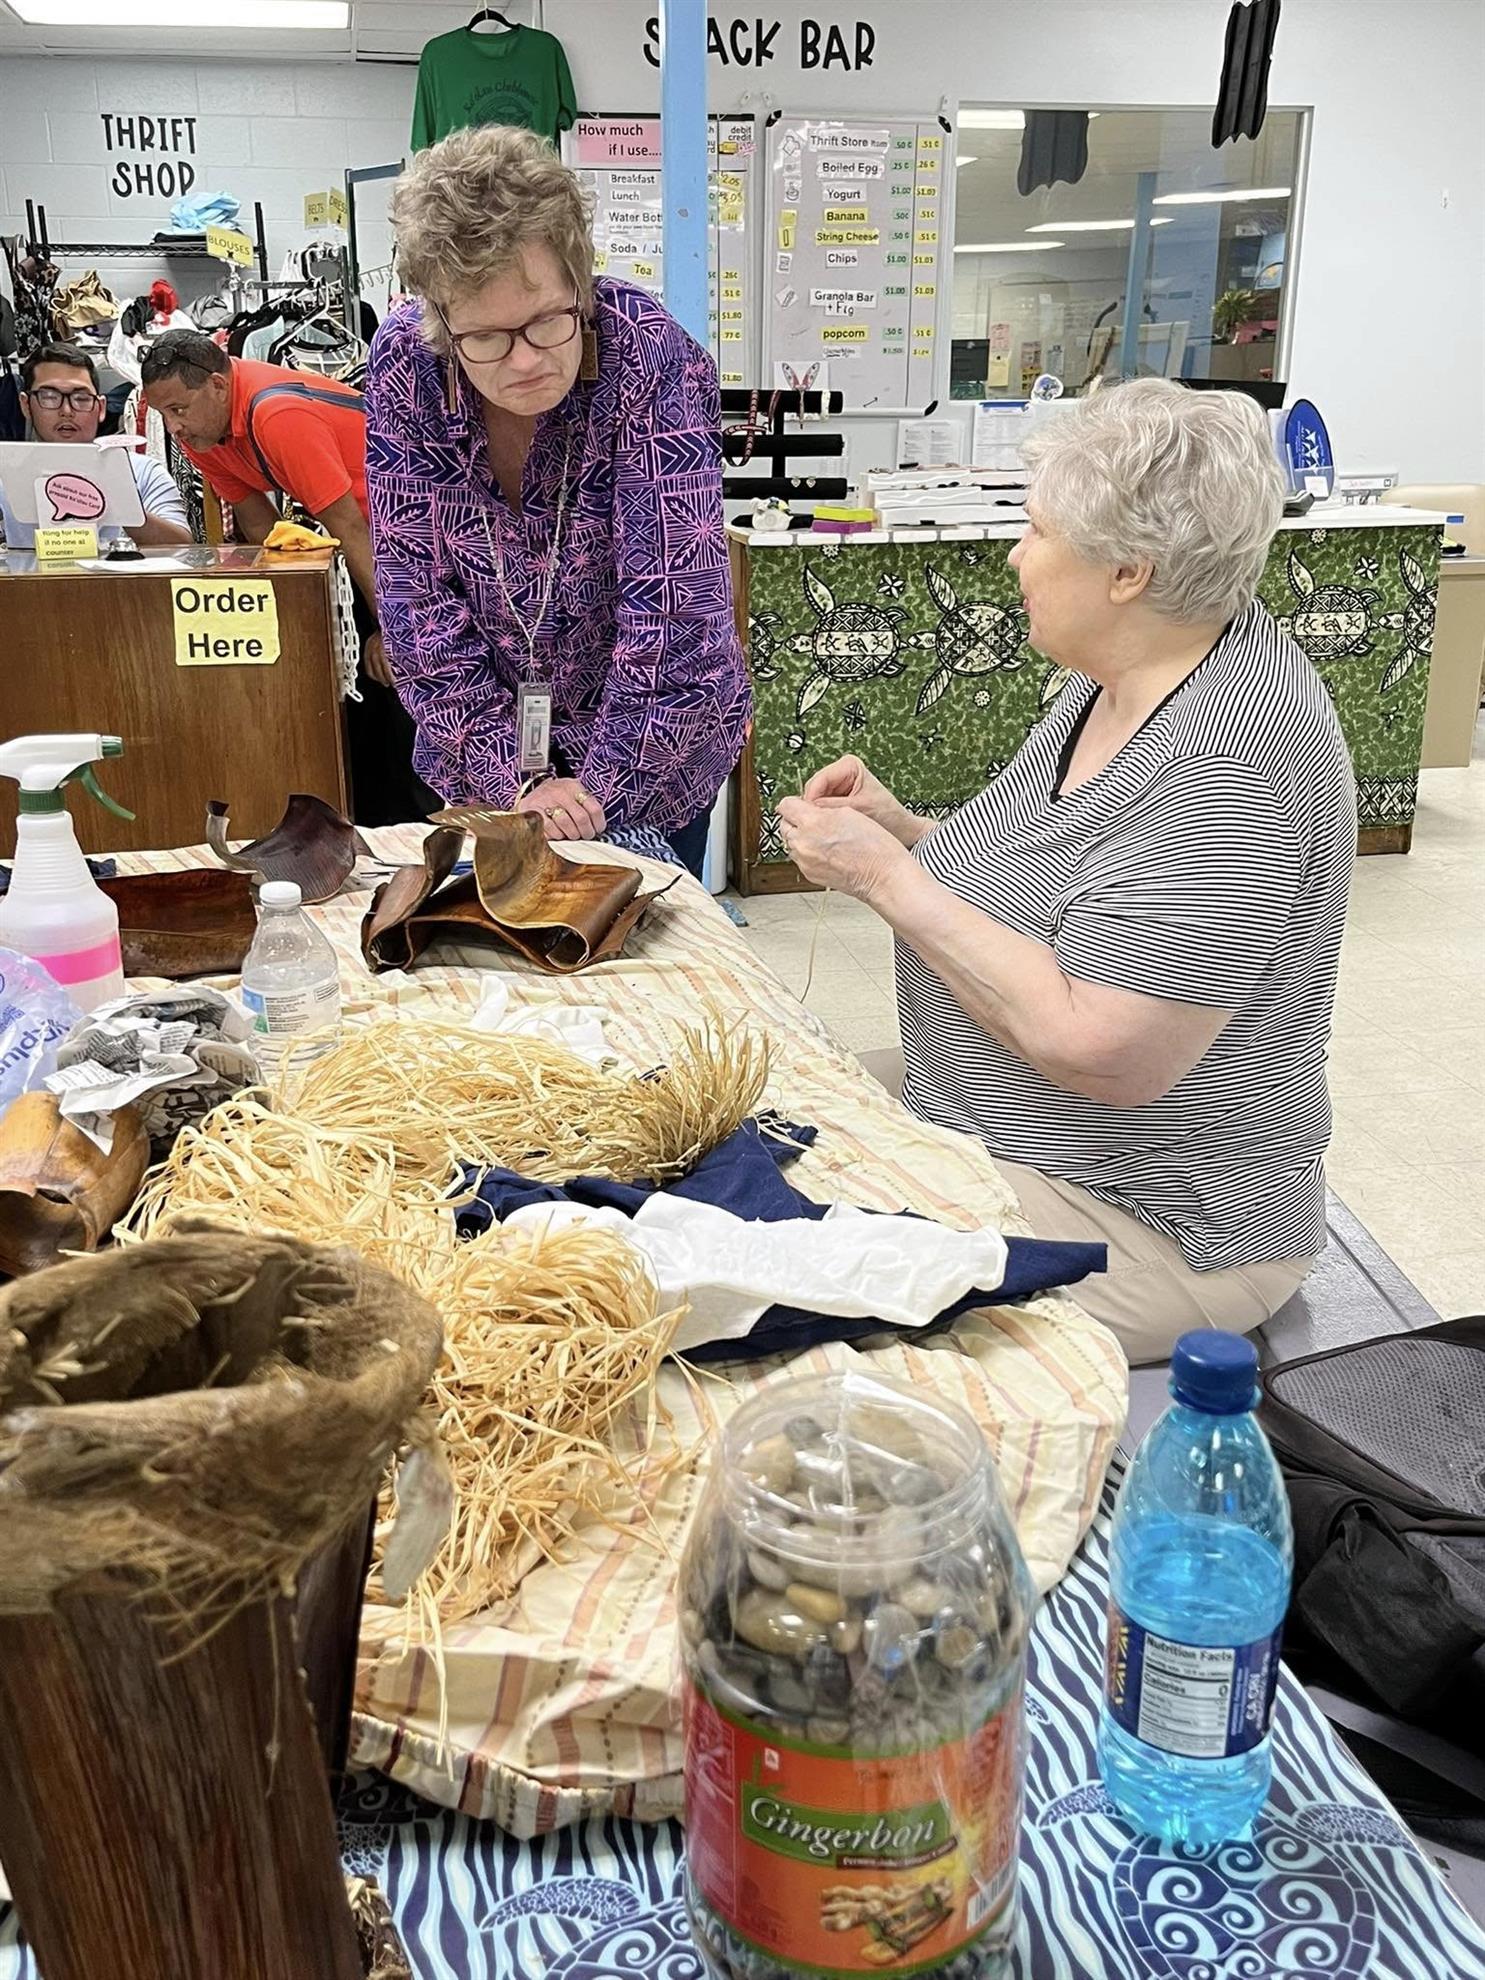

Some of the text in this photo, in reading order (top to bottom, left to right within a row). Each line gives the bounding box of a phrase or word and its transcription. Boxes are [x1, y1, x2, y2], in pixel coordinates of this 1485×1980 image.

[643, 17, 876, 71] SACK BAR
[101, 113, 197, 154] THRIFT
[578, 123, 643, 136] How much
[811, 136, 839, 146] Thrift
[841, 136, 869, 147] Store
[608, 143, 618, 156] if
[822, 162, 879, 175] Boiled Egg
[112, 161, 195, 198] SHOP
[611, 174, 655, 184] Breakfast
[612, 190, 640, 201] Lunch
[827, 189, 861, 202] Yogurt
[609, 212, 640, 222] Water
[826, 211, 866, 221] Banana
[816, 232, 879, 243] String Cheese
[208, 235, 251, 256] BLOUSES
[610, 243, 637, 253] Soda
[827, 253, 857, 264] Chips
[886, 255, 907, 264] $1.00
[913, 255, 934, 264] $1.03
[634, 263, 652, 275] Tea
[814, 290, 875, 302] Granola Bar
[885, 286, 906, 295] $1.00
[823, 330, 866, 340] popcorn
[175, 587, 269, 614] Order
[188, 633, 264, 658] Here
[1147, 1635, 1233, 1661] Nutrition Facts
[1143, 1671, 1186, 1694] Calories
[1218, 1684, 1229, 1698] 0
[750, 1797, 936, 1857] Gingerbon
